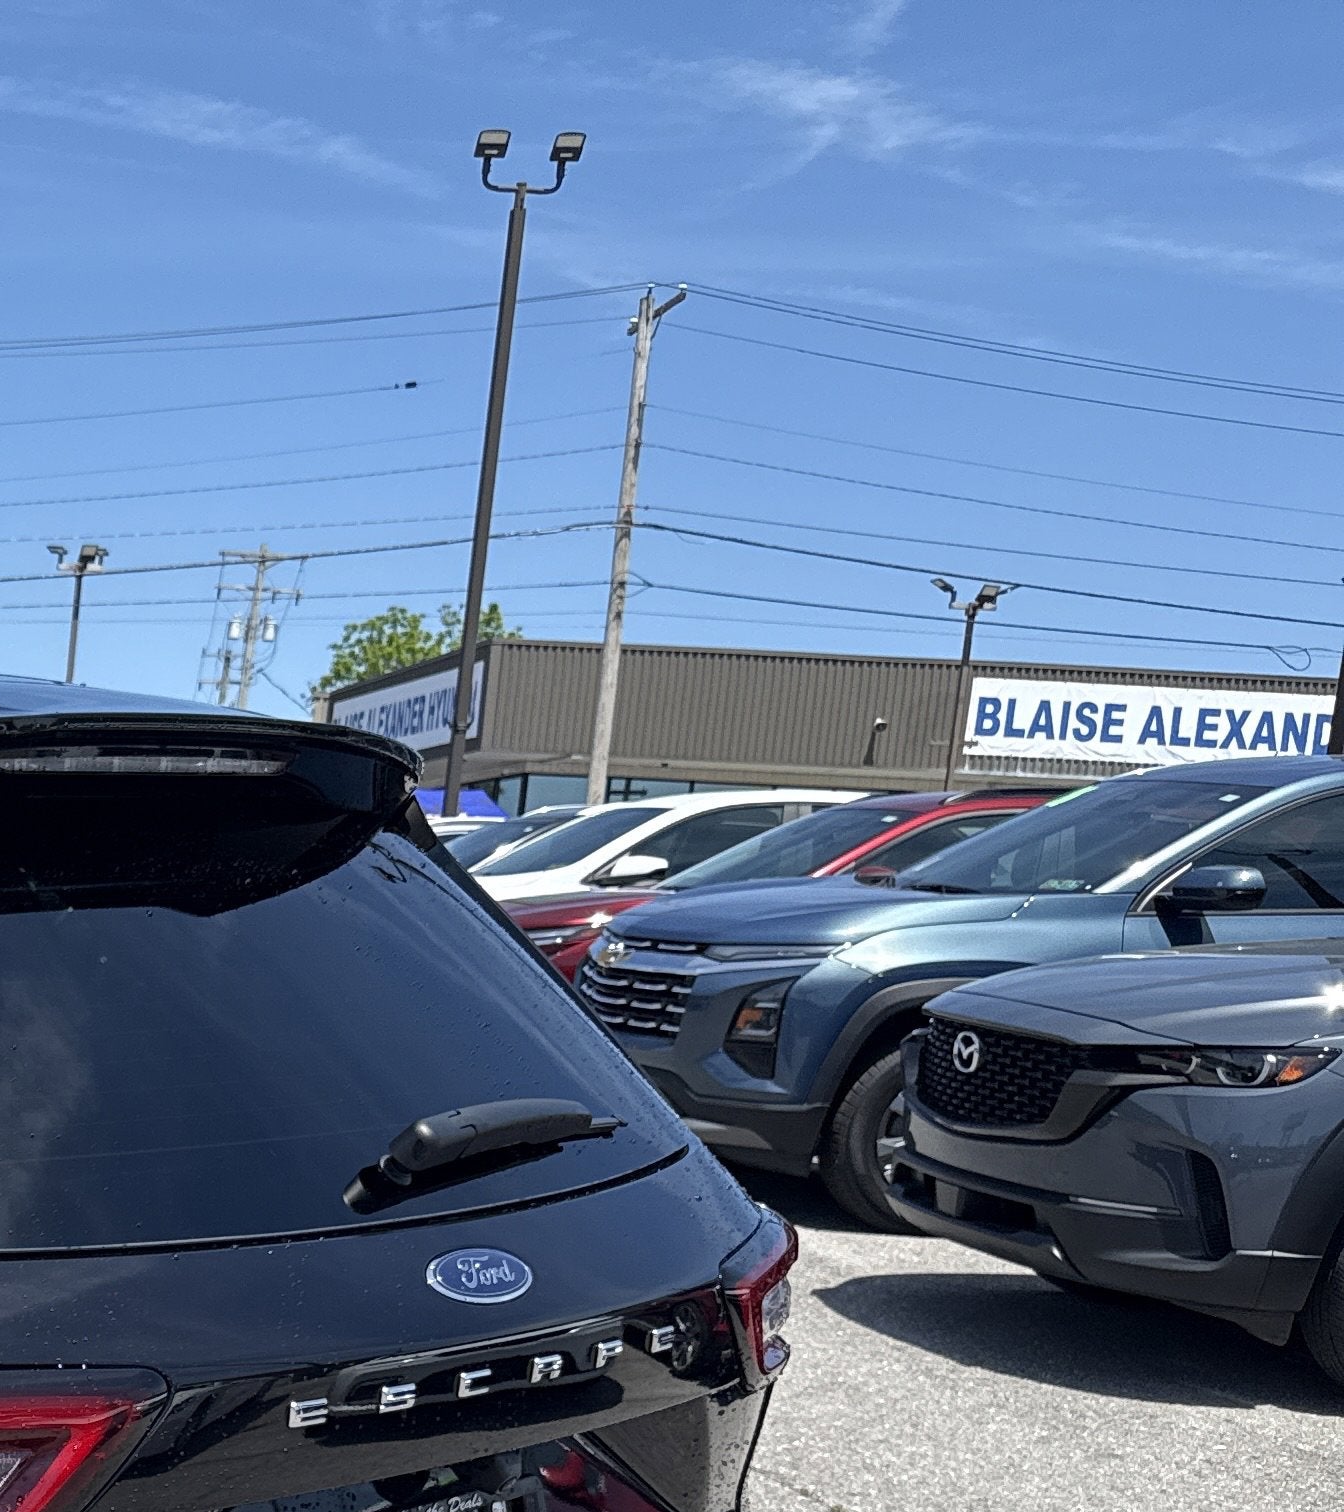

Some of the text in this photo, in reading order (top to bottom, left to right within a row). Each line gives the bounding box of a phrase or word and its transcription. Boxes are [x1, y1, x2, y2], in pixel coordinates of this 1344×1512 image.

[974, 697, 1128, 743] BLAISE
[456, 1256, 516, 1289] Ford
[288, 1325, 676, 1429] ESCAPE
